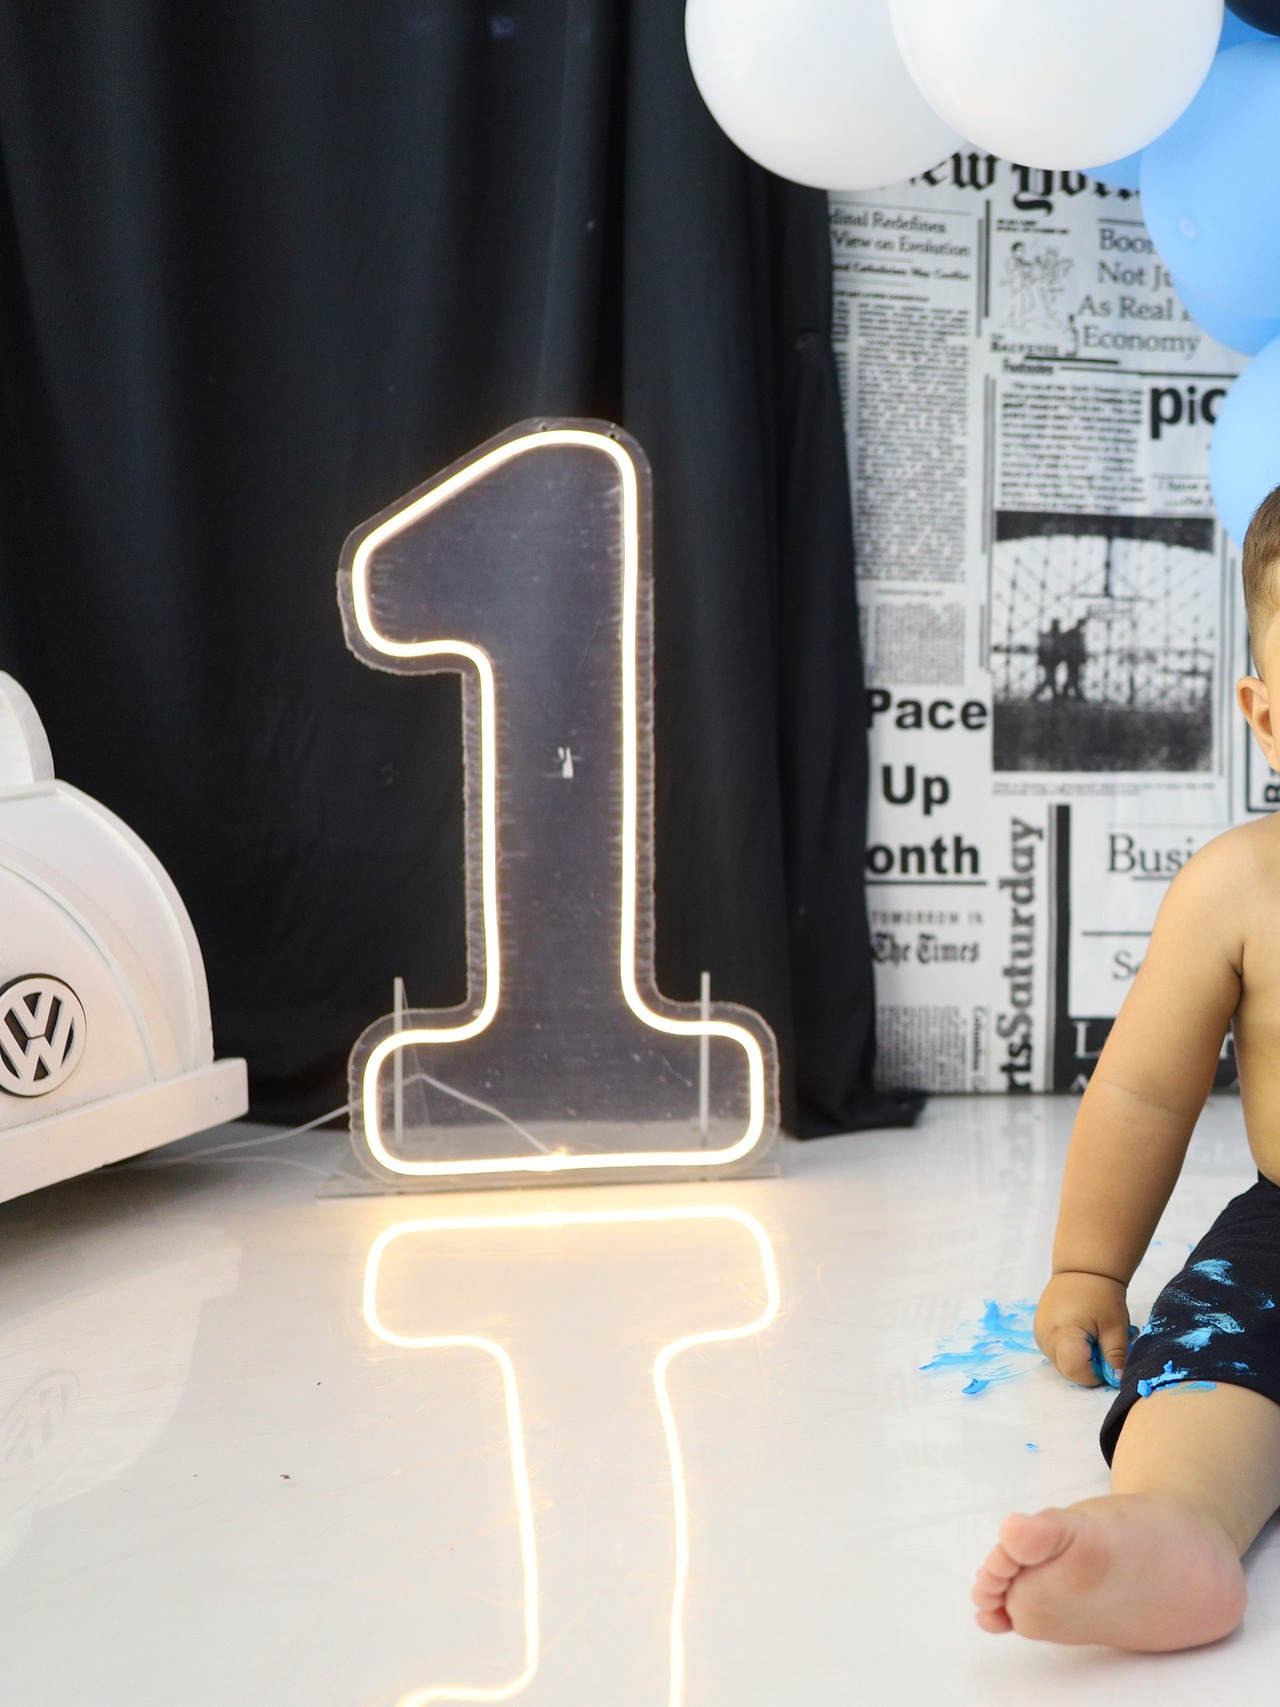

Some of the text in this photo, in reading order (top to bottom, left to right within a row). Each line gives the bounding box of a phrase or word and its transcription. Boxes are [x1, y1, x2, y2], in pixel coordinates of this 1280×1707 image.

[1099, 261, 1144, 287] Not
[1077, 294, 1174, 322] As Real
[1082, 324, 1201, 362] Economy
[868, 687, 988, 732] Pace
[876, 764, 951, 817] Up
[917, 932, 981, 965] Times
